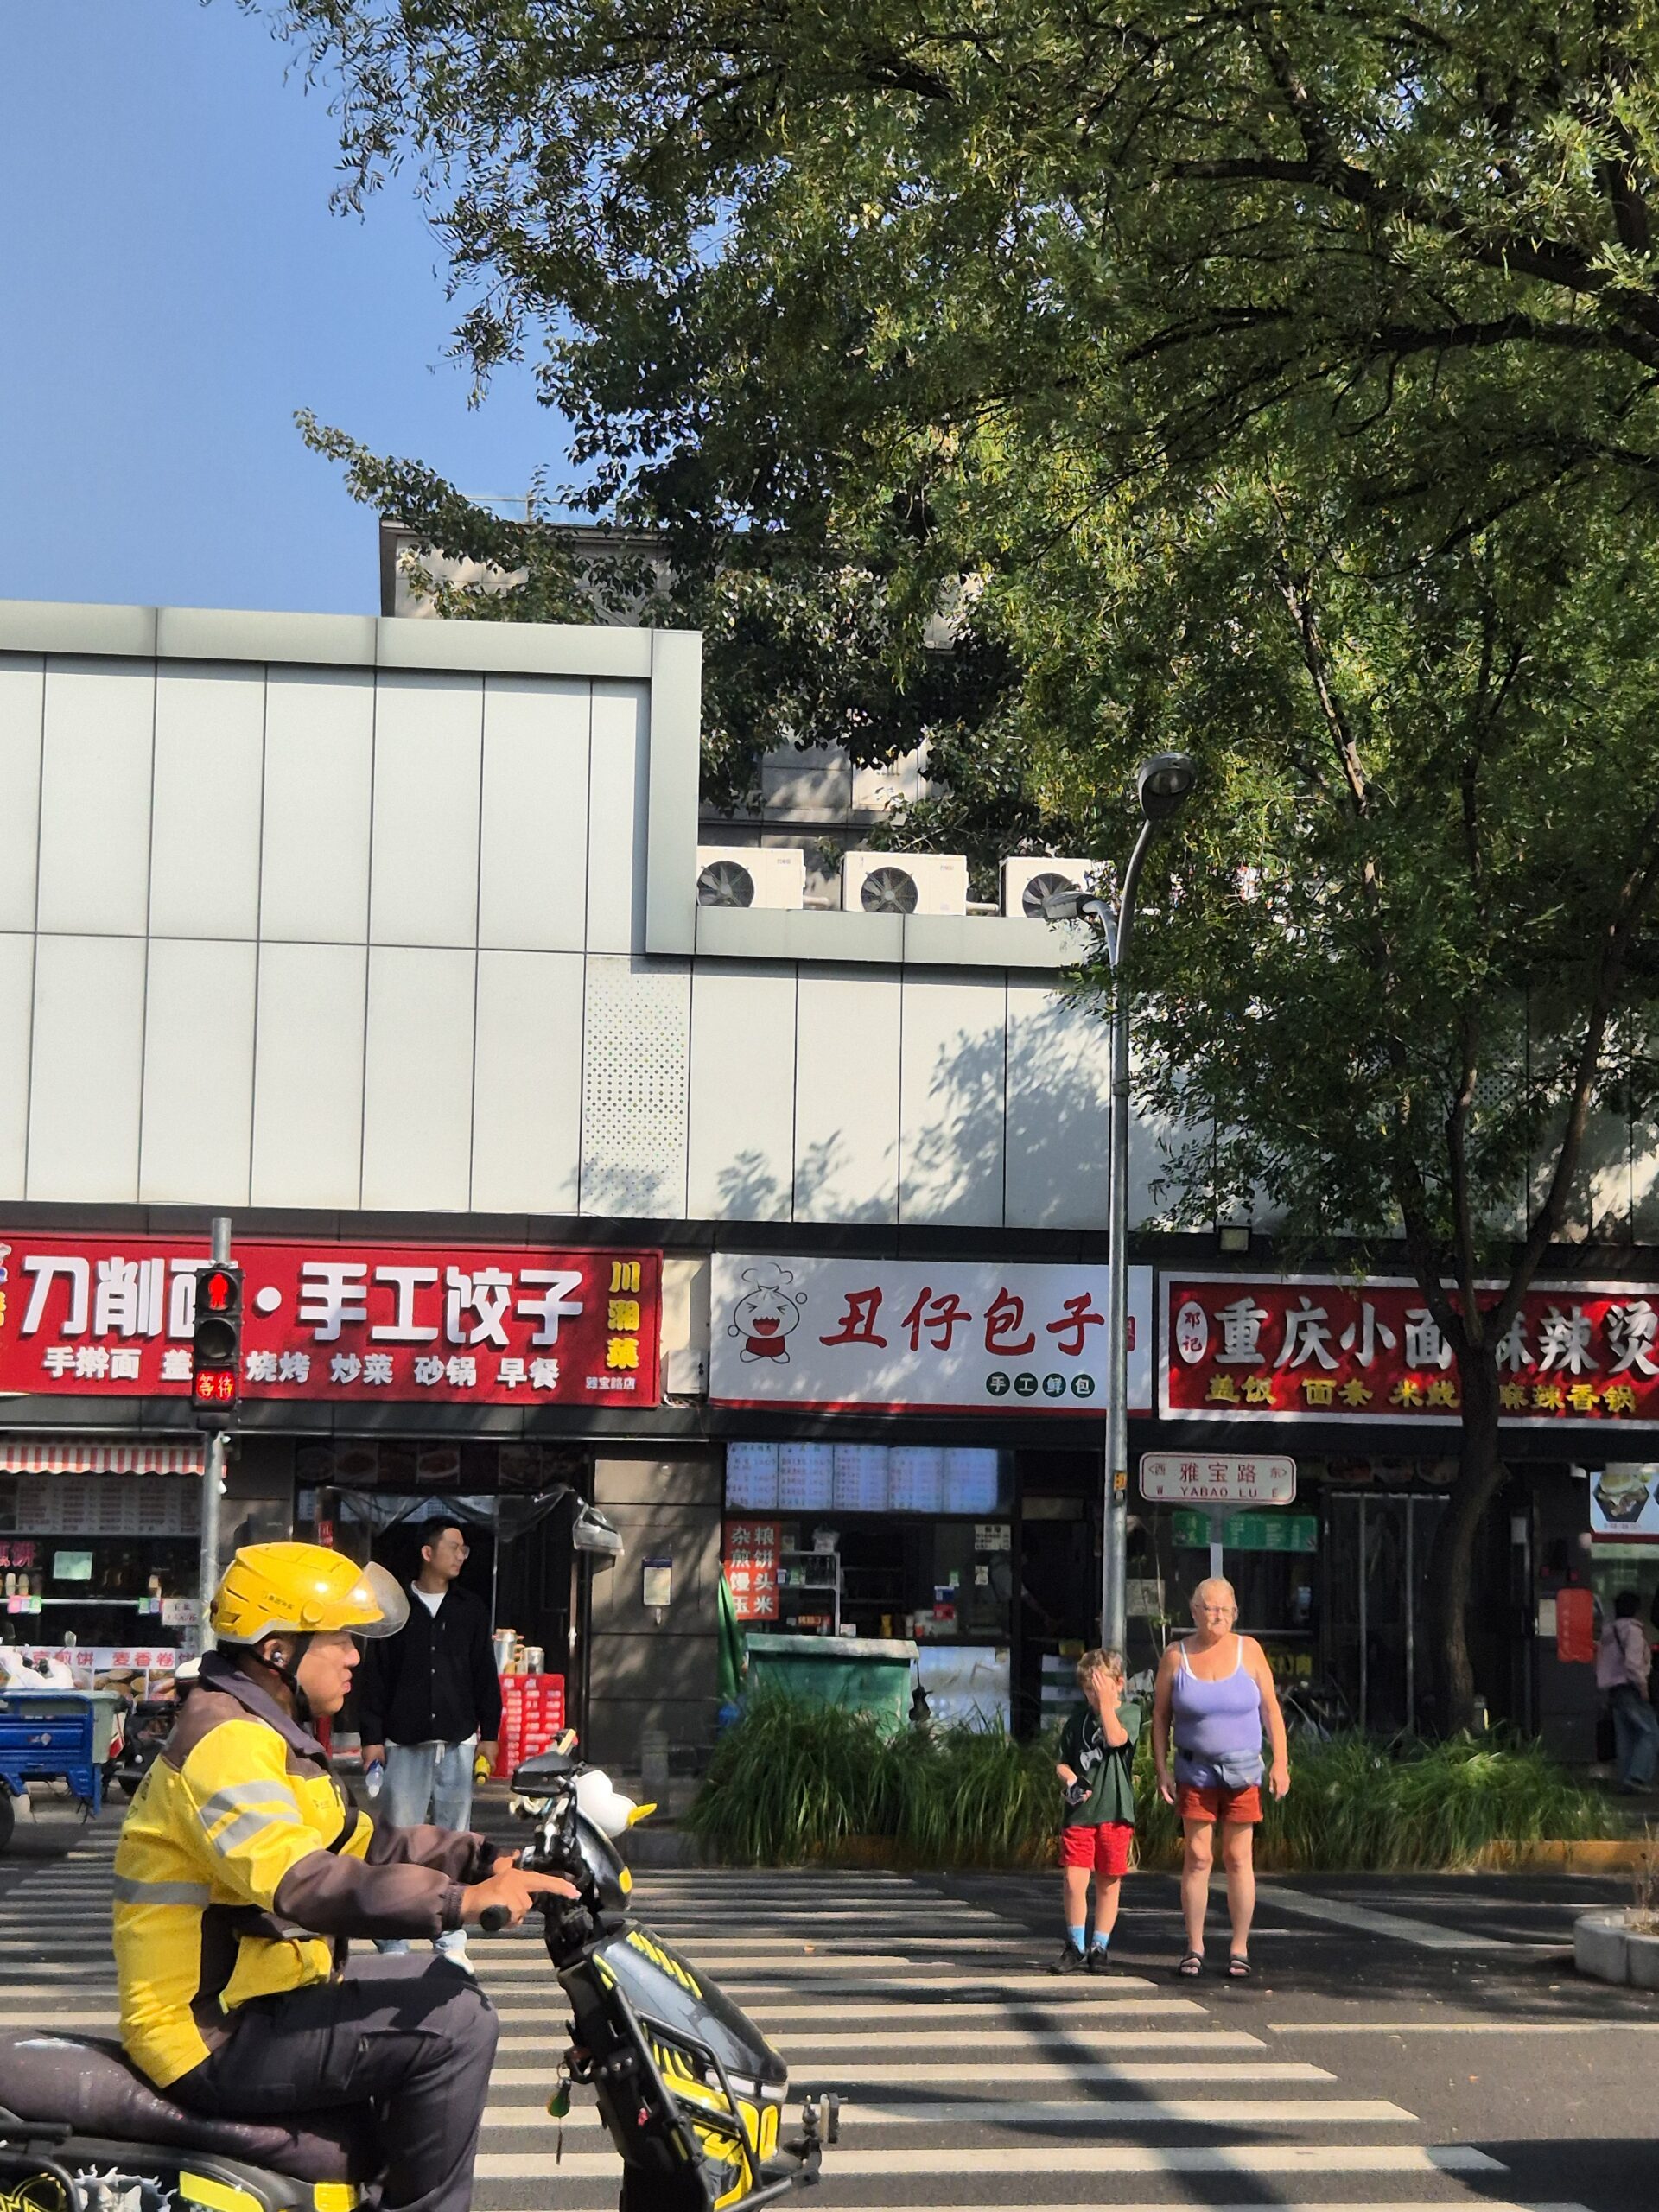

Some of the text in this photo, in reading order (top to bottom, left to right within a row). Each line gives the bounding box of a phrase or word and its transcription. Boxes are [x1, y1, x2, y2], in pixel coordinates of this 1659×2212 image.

[606, 1260, 641, 1370] 川湘菜
[818, 1286, 1105, 1357] 丑仔包子
[1182, 1311, 1203, 1352] 邓记
[44, 1346, 142, 1380] 手擀面
[246, 1351, 311, 1383] 烧烤
[330, 1353, 393, 1385] 炒菜
[415, 1355, 477, 1387] 砂锅
[497, 1357, 560, 1389] 早餐
[199, 1373, 234, 1398] 等待
[988, 1374, 1092, 1395] 手工鲜包
[1302, 1377, 1374, 1407] 面条
[1499, 1381, 1637, 1414] 麻辣香锅
[1154, 1462, 1282, 1484] 西 雅宝路 东
[1156, 1486, 1279, 1498] W YABAO LU E
[731, 1526, 774, 1545] 杂粮
[730, 1549, 774, 1568] 煎饼
[729, 1572, 773, 1591] 馒头
[733, 1595, 773, 1614] 玉米
